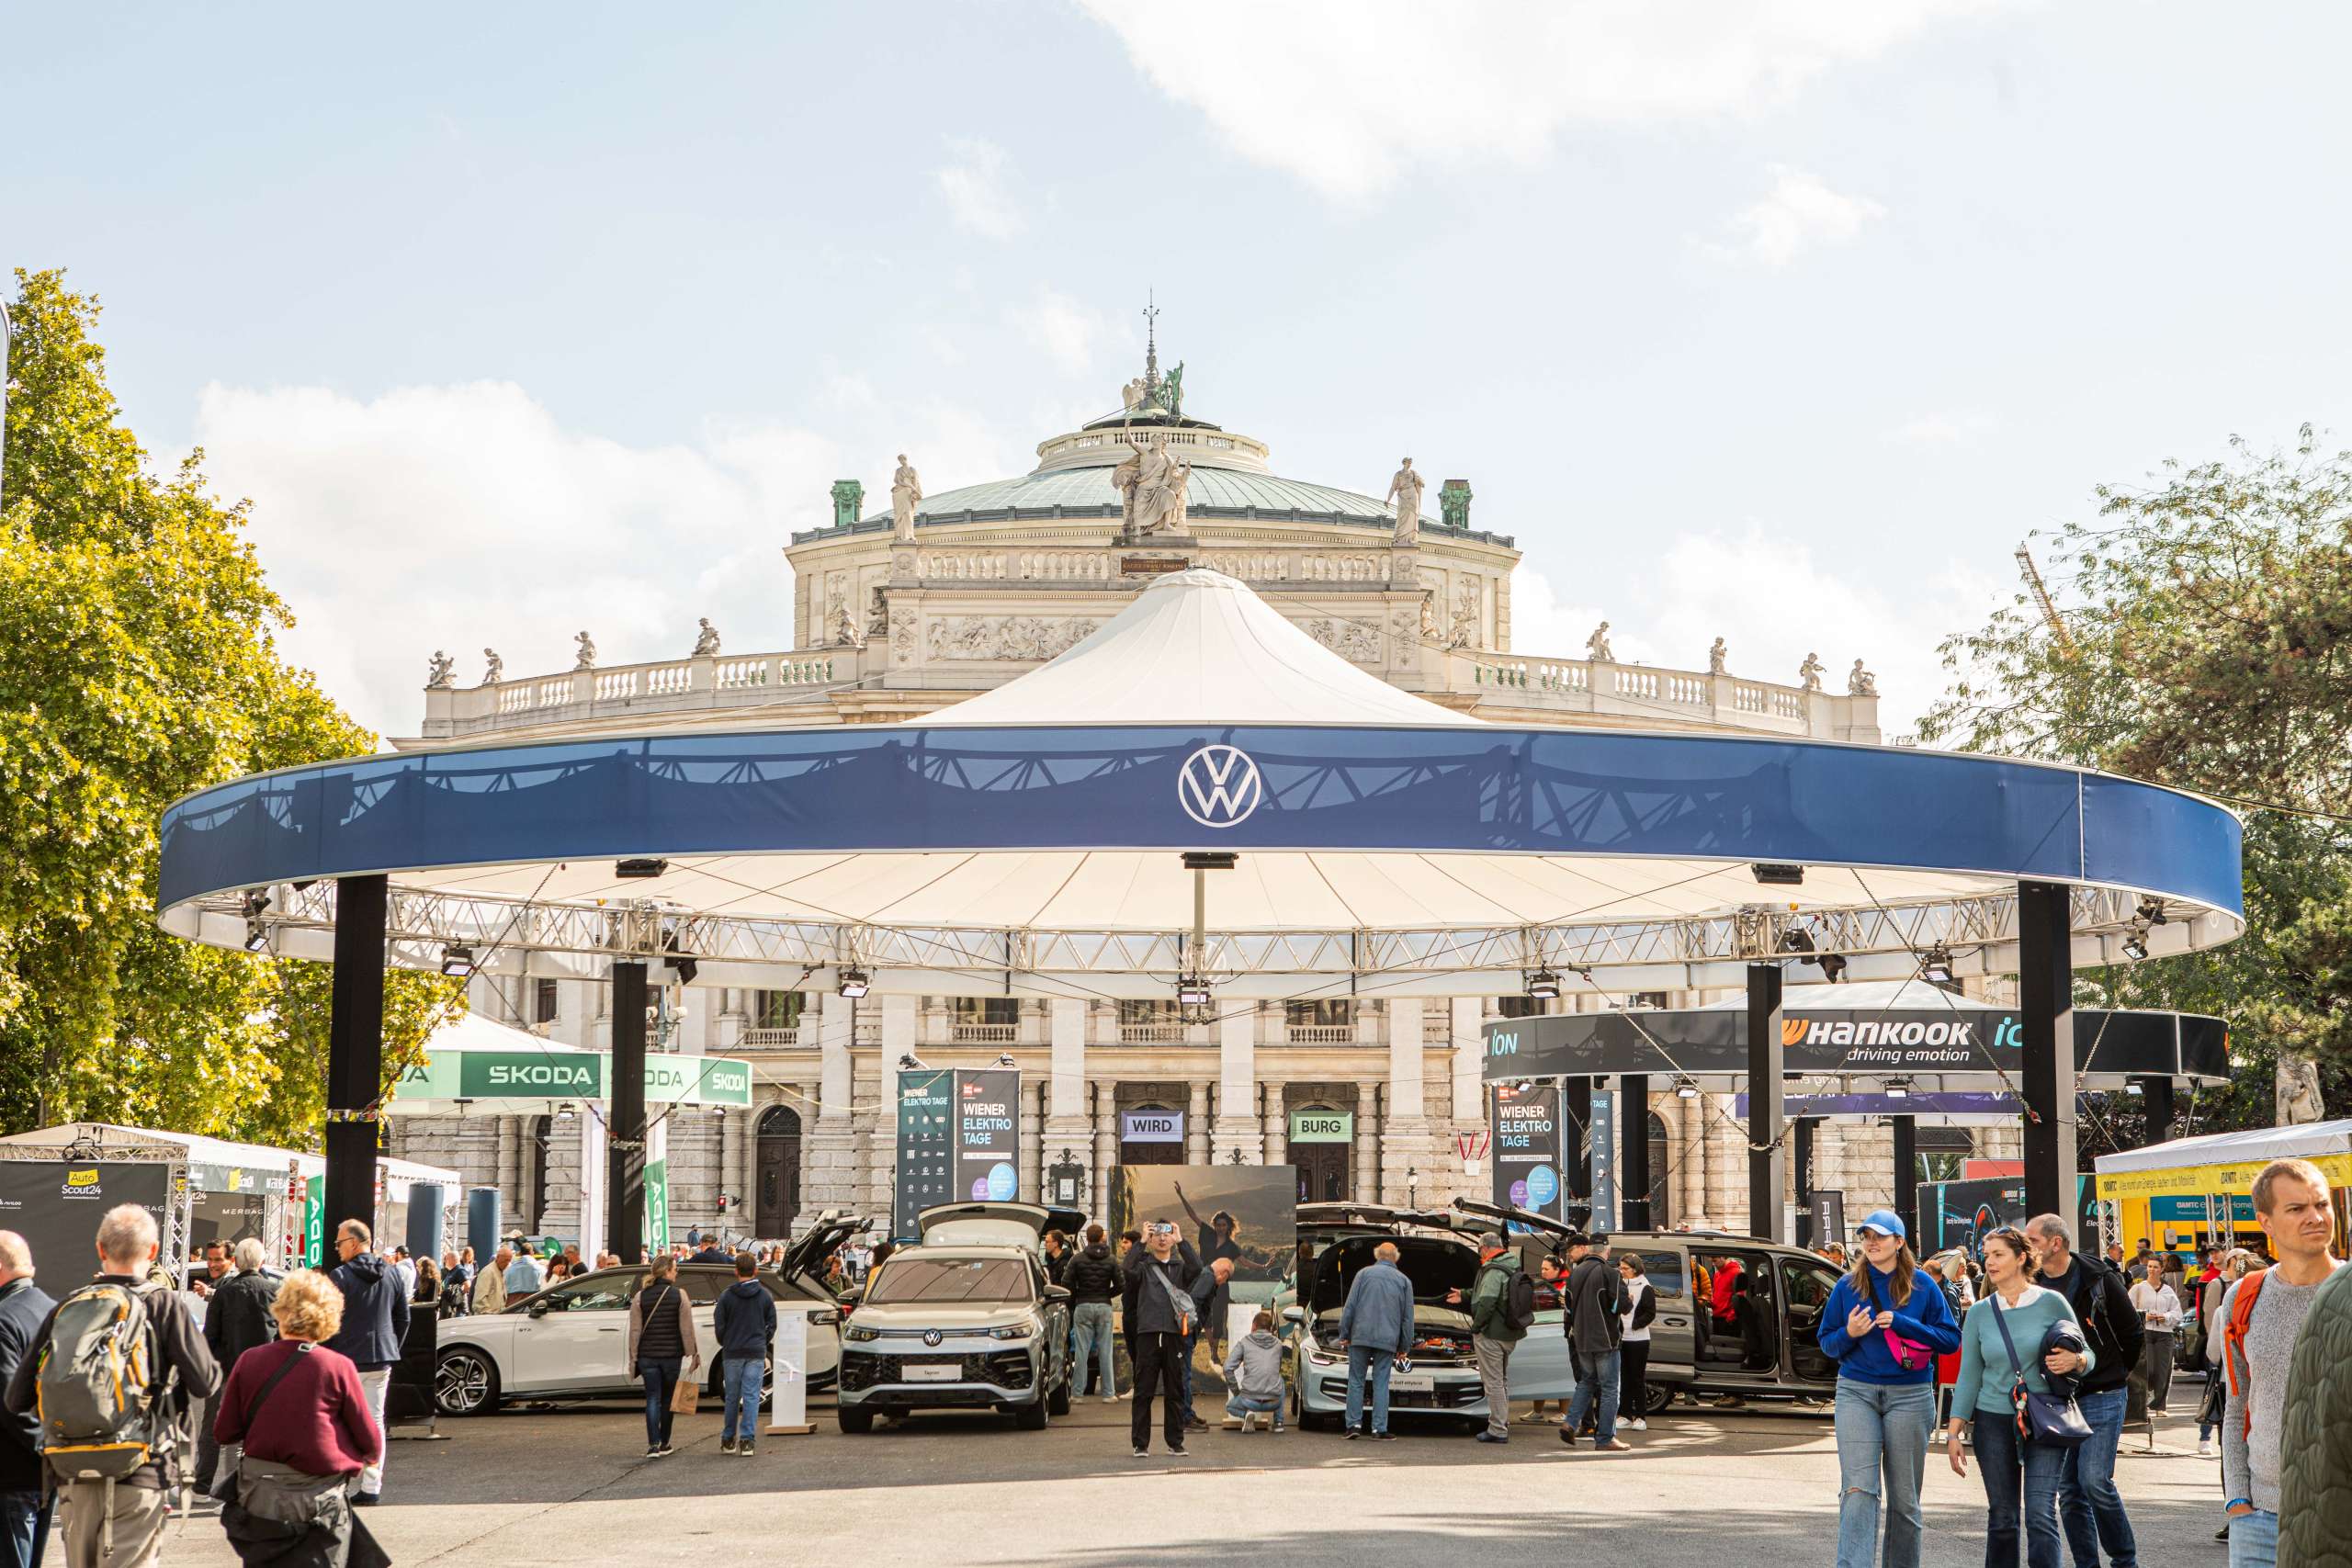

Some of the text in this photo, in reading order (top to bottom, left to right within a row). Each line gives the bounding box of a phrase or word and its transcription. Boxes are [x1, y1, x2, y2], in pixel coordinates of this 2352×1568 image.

[1847, 1048, 1970, 1065] driving emotion
[903, 1089, 928, 1098] WIENER
[903, 1097, 948, 1107] ELEKTRO TAGE
[1592, 1100, 1608, 1109] TAGE
[963, 1103, 1006, 1116] WIENER
[1499, 1105, 1545, 1119] WIENER
[963, 1118, 1012, 1131] ELEKTRO
[1132, 1119, 1173, 1133] WIRD
[1301, 1119, 1341, 1134] BURG
[1499, 1120, 1553, 1133] ELEKTRO
[963, 1133, 992, 1145] TAGE
[1499, 1134, 1531, 1147] TAGE
[71, 1173, 96, 1183] Auto
[62, 1184, 102, 1195] Scout24
